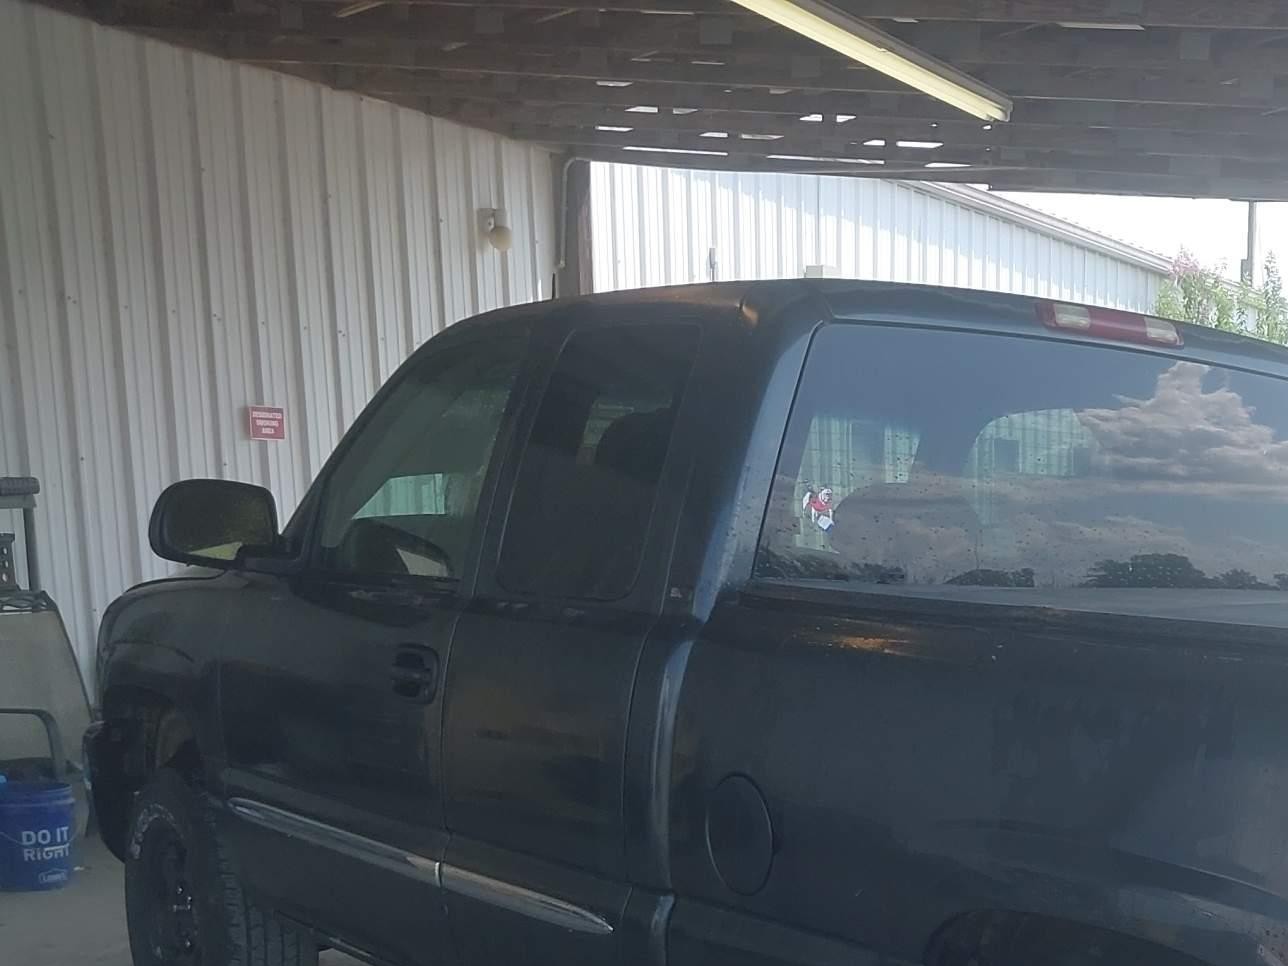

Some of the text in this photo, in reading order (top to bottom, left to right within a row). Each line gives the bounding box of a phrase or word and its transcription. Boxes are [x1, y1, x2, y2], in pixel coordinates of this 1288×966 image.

[21, 826, 69, 846] DO IT
[23, 843, 70, 861] RIGHT
